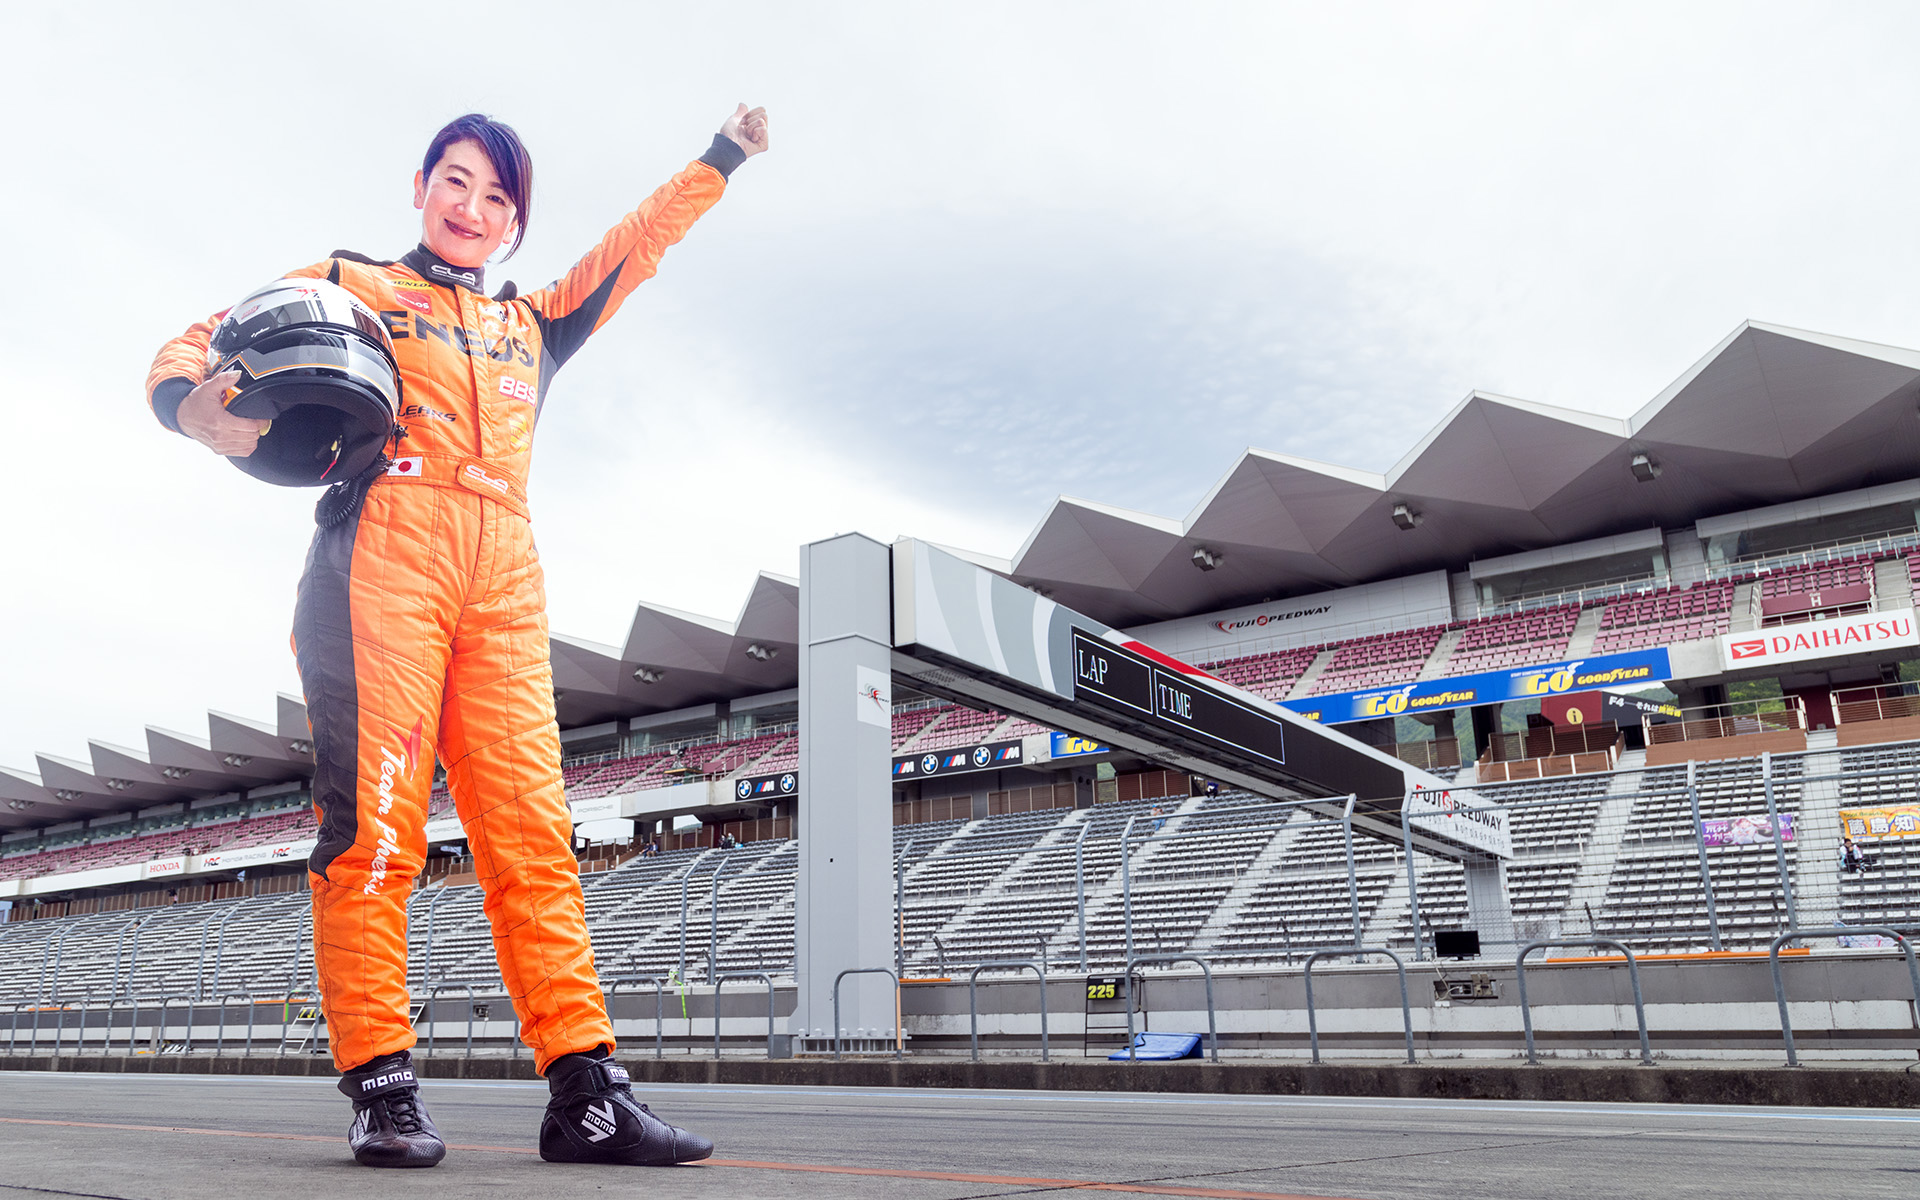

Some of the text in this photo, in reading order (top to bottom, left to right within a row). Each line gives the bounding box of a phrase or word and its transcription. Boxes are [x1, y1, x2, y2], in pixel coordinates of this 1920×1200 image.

[379, 310, 536, 368] ENEOS
[499, 376, 537, 406] BBS
[1811, 596, 1821, 607] H
[1772, 618, 1911, 654] DAIHATSU
[1079, 649, 1108, 685] LAP
[1527, 667, 1649, 694] GO GOODYEAR
[1159, 683, 1193, 720] TIME
[1366, 691, 1473, 715] GO GOODYEAR
[378, 745, 407, 815] Team
[149, 861, 180, 873] HONDA
[1088, 984, 1115, 999] 225
[361, 1070, 414, 1092] momo
[585, 1111, 617, 1135] momo
